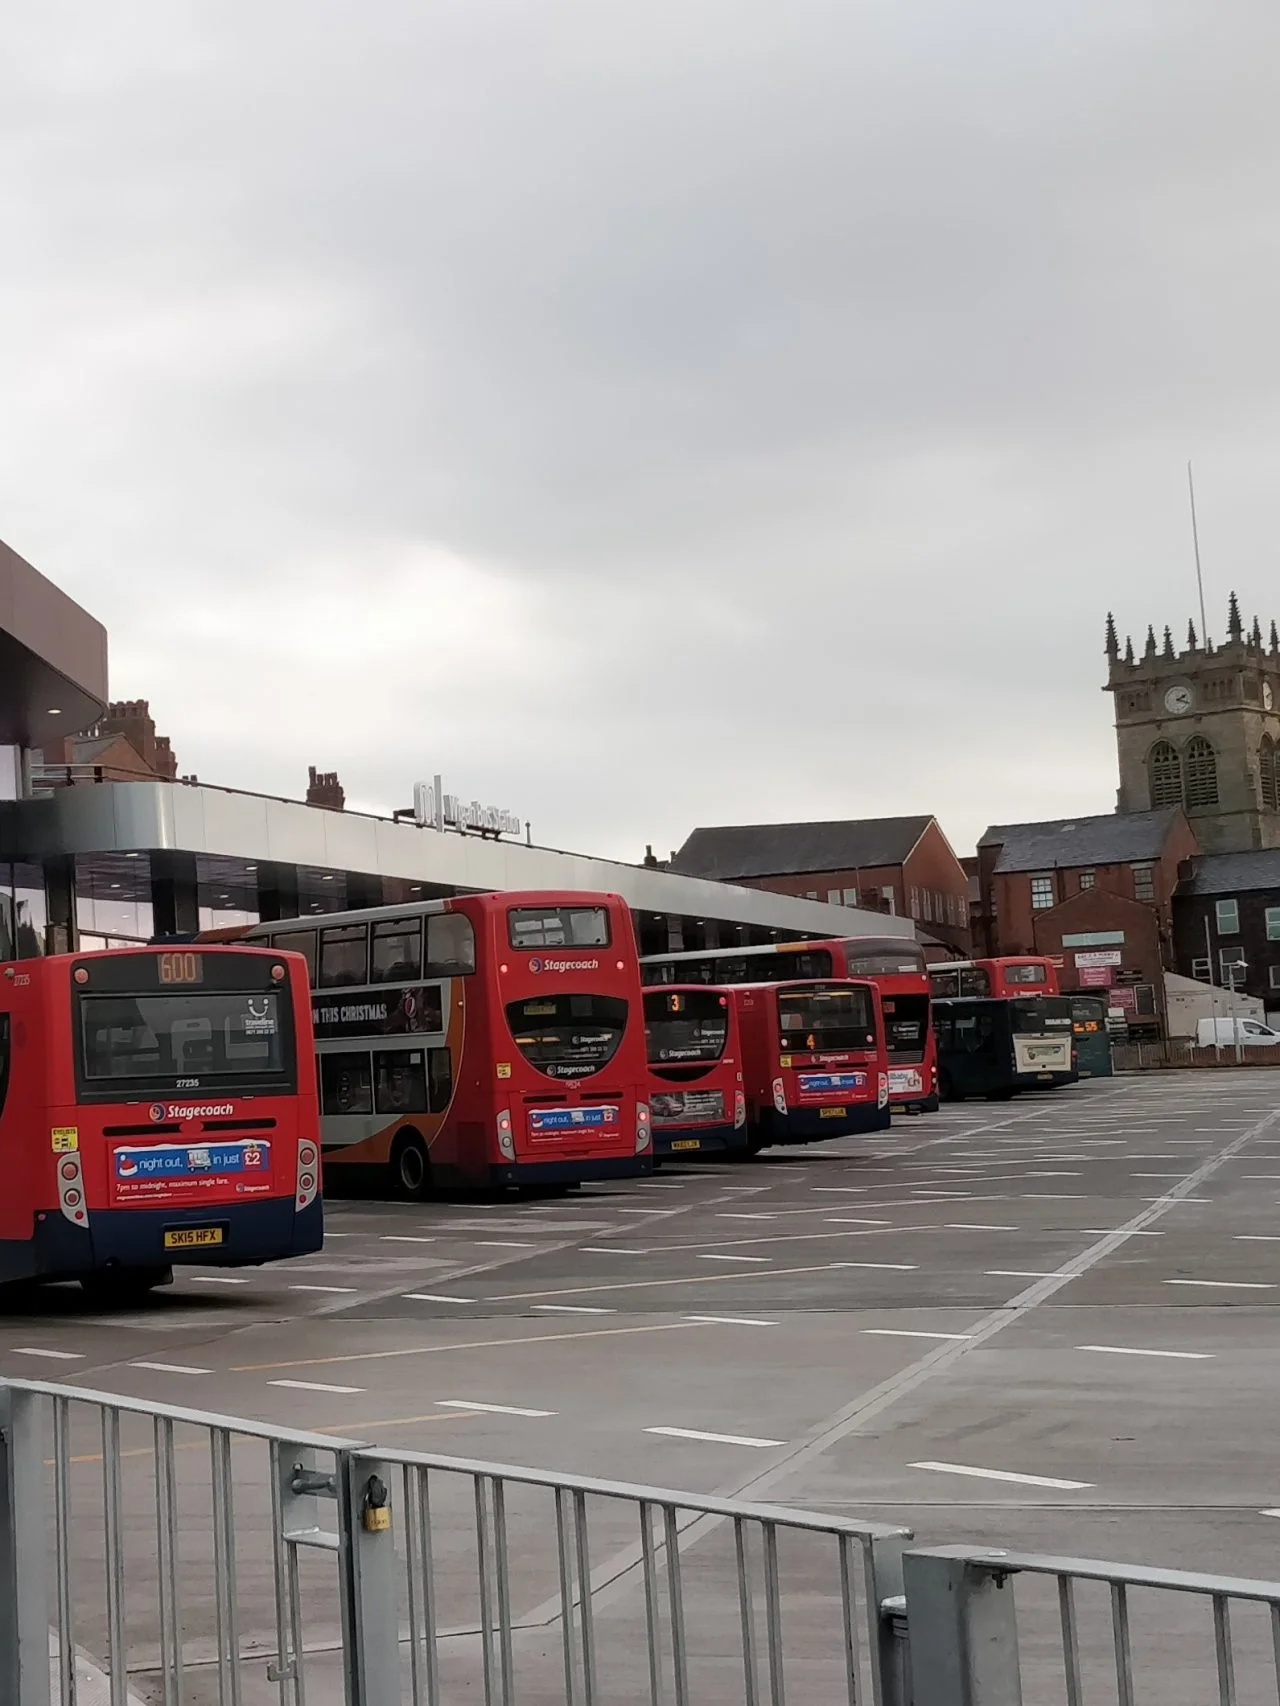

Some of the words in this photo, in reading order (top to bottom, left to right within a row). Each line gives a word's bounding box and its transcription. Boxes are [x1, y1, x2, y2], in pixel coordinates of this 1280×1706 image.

[161, 953, 196, 981] 600
[544, 959, 598, 972] Stagecoach
[671, 994, 680, 1012] 3
[320, 1007, 339, 1023] THIS
[340, 1003, 387, 1022] CHRISTMAS
[557, 1065, 595, 1076] Stagecoach
[175, 1079, 200, 1088] 27235
[167, 1103, 234, 1120] Stagecoach
[139, 1157, 163, 1171] night
[164, 1157, 183, 1168] out,
[213, 1153, 222, 1164] in
[222, 1152, 240, 1166] just
[244, 1152, 261, 1165] £2
[198, 1176, 216, 1186] single
[170, 1231, 194, 1244] SK15
[195, 1229, 216, 1242] HFX
